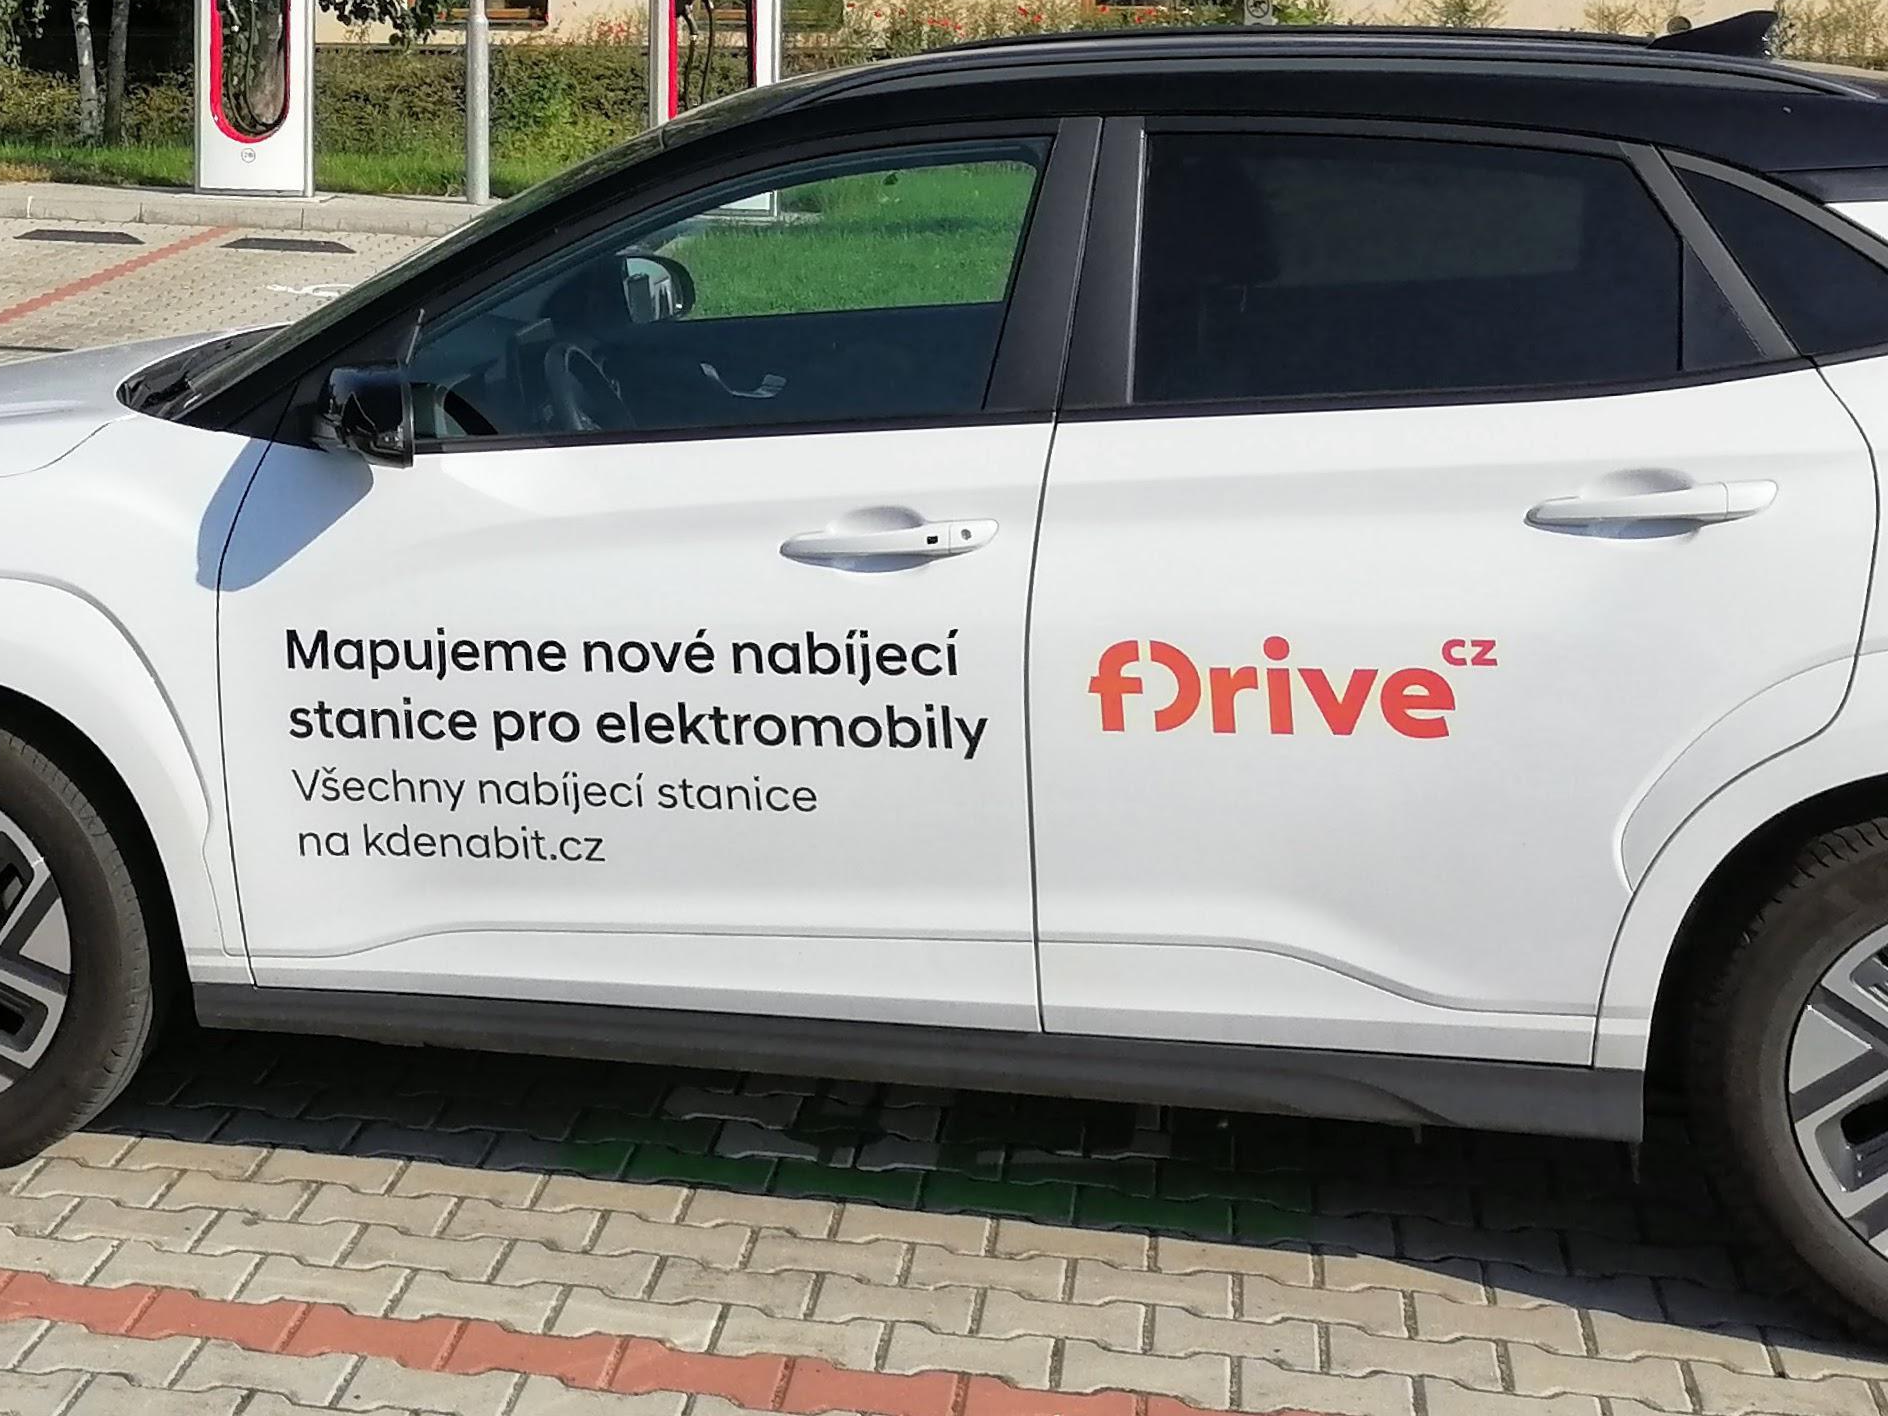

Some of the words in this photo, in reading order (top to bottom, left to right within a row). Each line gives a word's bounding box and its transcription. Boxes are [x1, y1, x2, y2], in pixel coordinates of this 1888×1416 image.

[286, 627, 567, 681] Mapujeme
[582, 628, 715, 674] nové
[731, 628, 959, 686] nabíjecí
[289, 696, 478, 741] stanice
[492, 710, 581, 751] pro
[596, 701, 989, 760] elektromobily
[291, 766, 466, 812] Všechny
[478, 770, 644, 815] nabíjecí
[657, 775, 817, 813] stanice
[298, 832, 350, 857] na
[362, 823, 606, 862] kdenabit.cz
